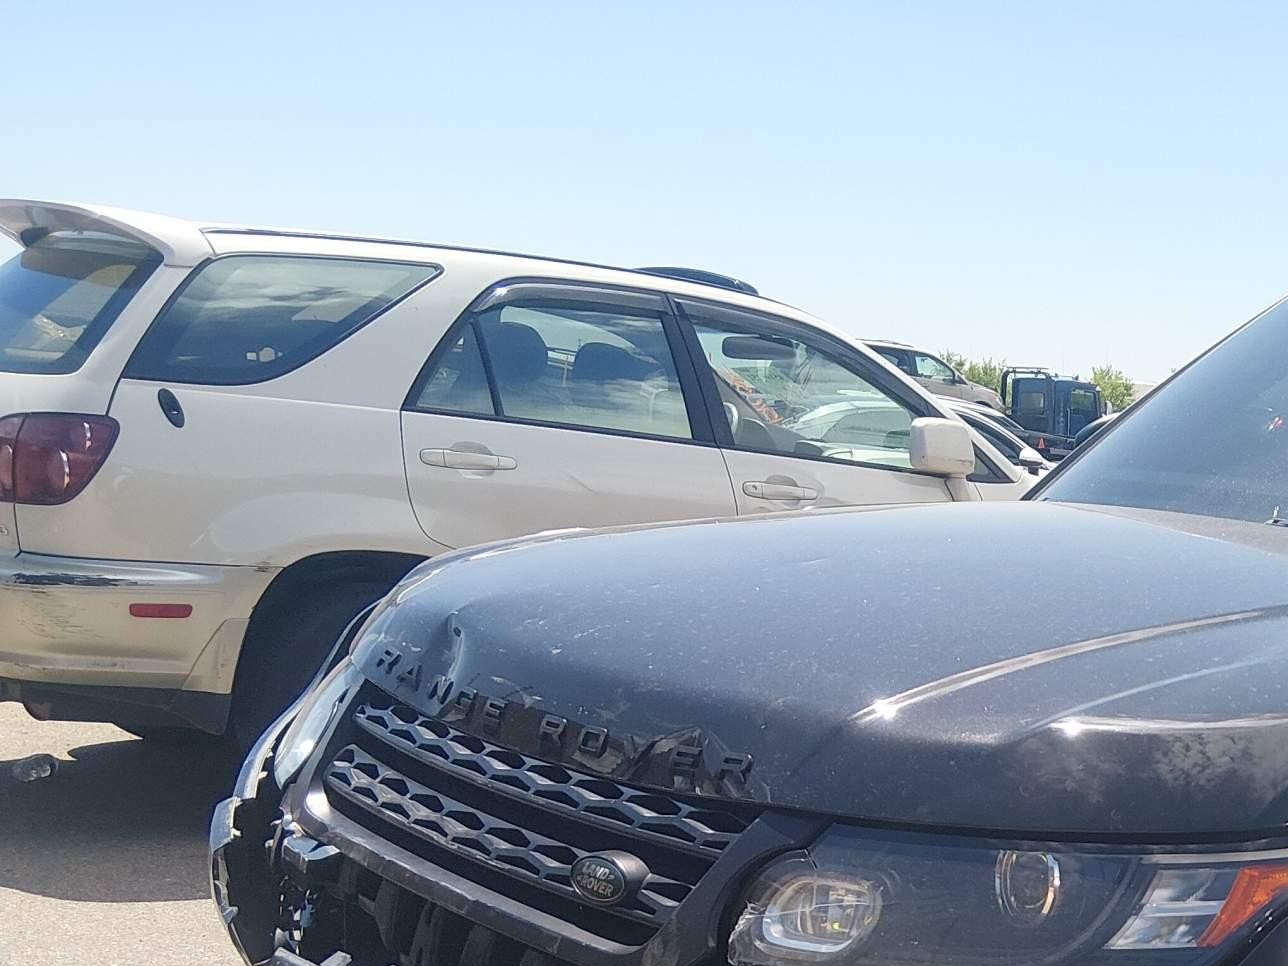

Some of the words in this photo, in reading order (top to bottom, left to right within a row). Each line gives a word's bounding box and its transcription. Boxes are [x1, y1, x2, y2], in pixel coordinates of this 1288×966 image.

[376, 647, 507, 718] RANGE
[582, 861, 610, 880] LAND
[580, 874, 615, 897] ROVER
